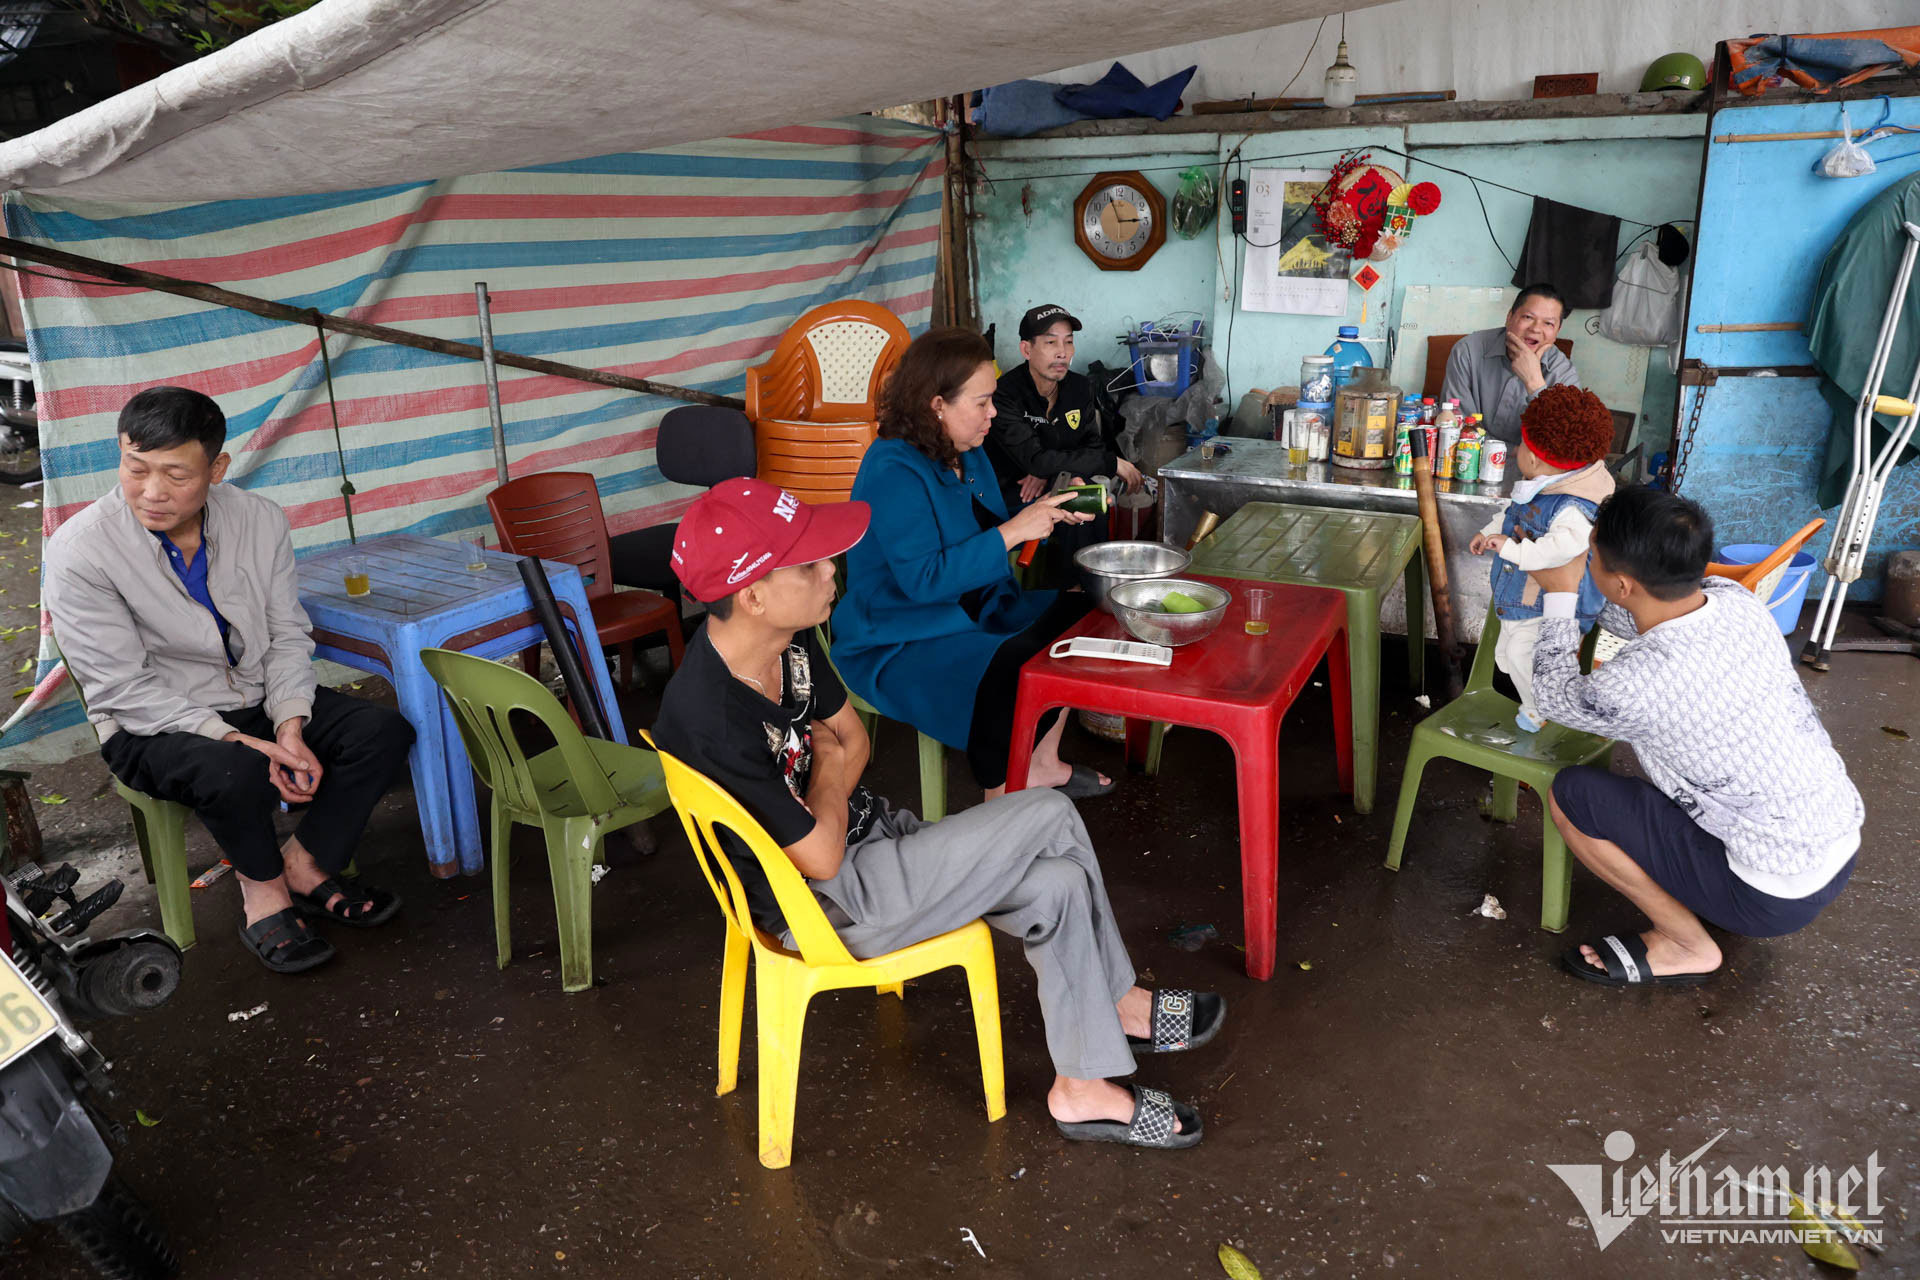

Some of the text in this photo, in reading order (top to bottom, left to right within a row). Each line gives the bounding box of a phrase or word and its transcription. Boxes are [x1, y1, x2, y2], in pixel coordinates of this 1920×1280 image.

[1116, 187, 1124, 197] 12
[1093, 202, 1101, 211] 10
[1139, 201, 1145, 211] 2
[1090, 216, 1097, 226] 9
[1143, 216, 1149, 226] 3
[1094, 231, 1101, 240] 8
[1139, 231, 1145, 240] 4
[1105, 242, 1111, 251] 7
[1117, 244, 1123, 254] 6
[1130, 241, 1136, 251] 5
